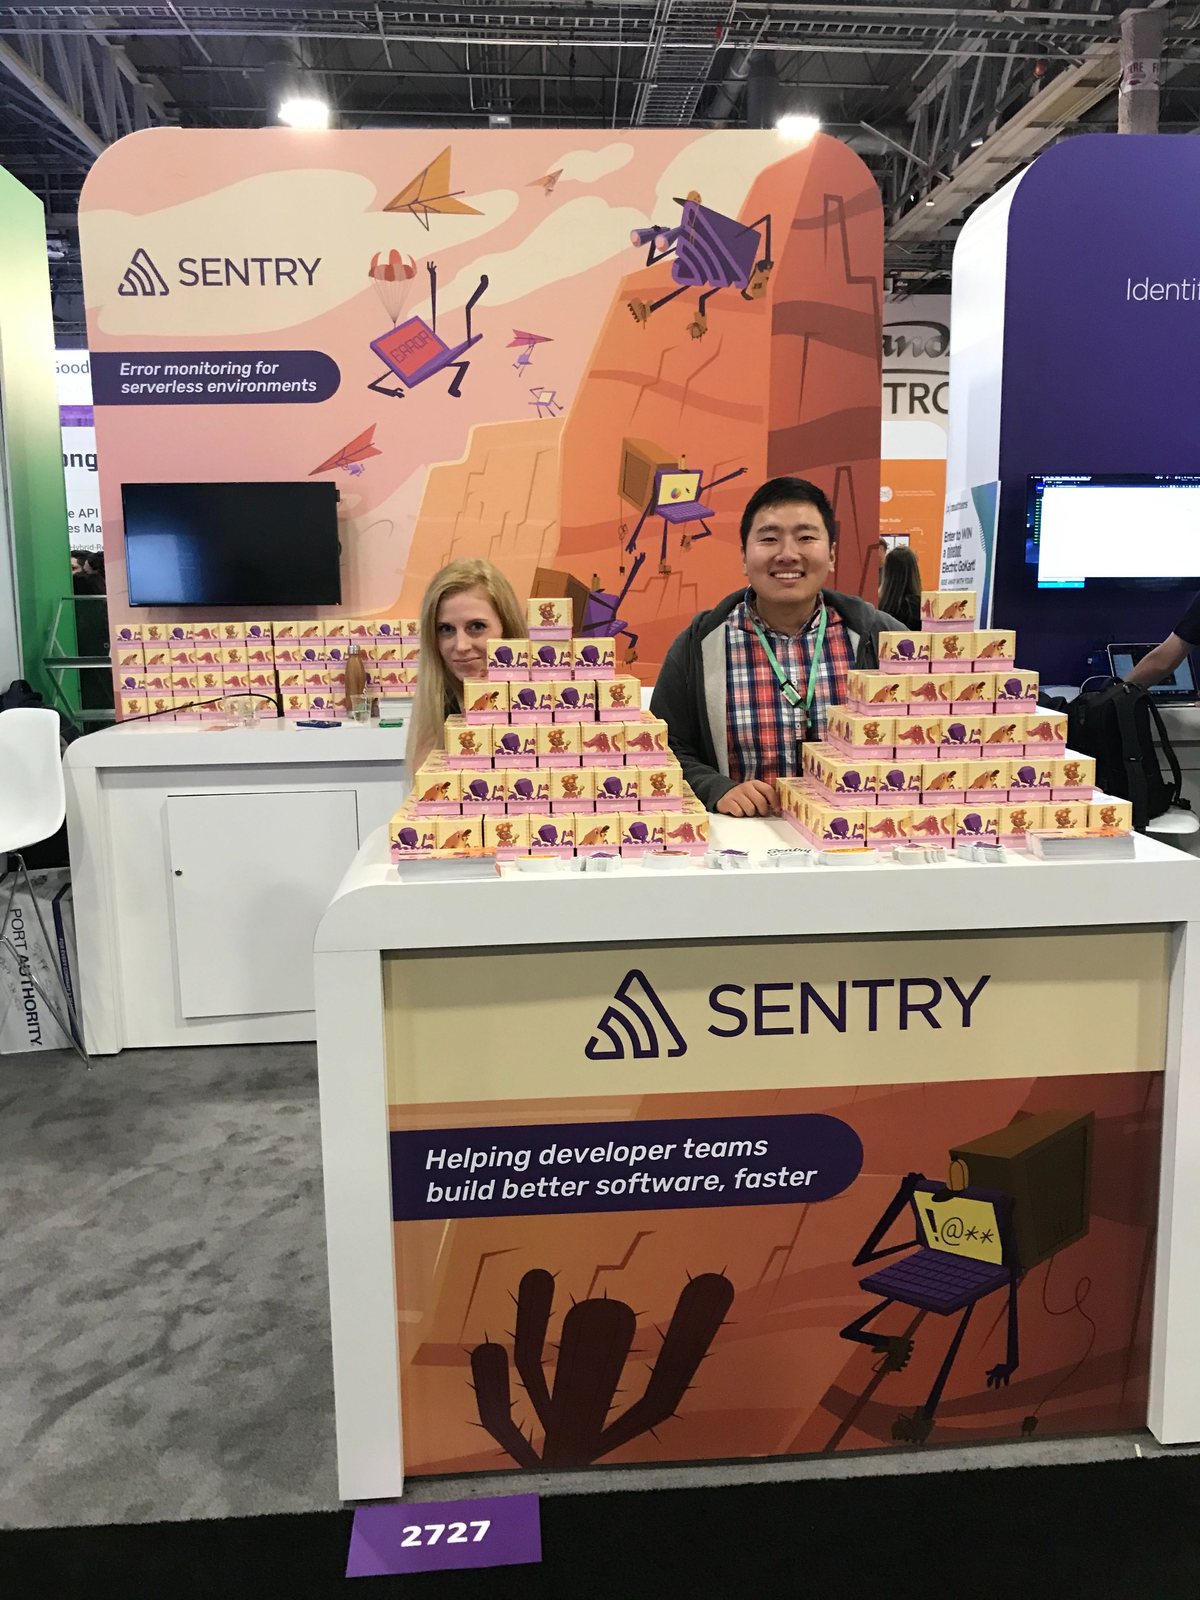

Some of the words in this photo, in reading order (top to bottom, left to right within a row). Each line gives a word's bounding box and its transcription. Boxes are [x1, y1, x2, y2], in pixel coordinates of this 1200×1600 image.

[178, 257, 322, 287] SENTRY
[389, 330, 433, 364] ERROR
[119, 362, 161, 376] Error
[164, 361, 251, 378] monitoring
[255, 361, 279, 375] for
[121, 380, 203, 394] serverless
[207, 378, 317, 393] environments
[78, 508, 98, 518] API
[962, 527, 973, 539] WIN
[9, 908, 28, 950] PORT
[707, 974, 991, 1038] SENTRY
[425, 1145, 531, 1172] Helping
[538, 1142, 677, 1167] developer
[682, 1137, 769, 1159] teams
[425, 1179, 495, 1203] build
[502, 1176, 589, 1200] better
[595, 1171, 725, 1196] software,
[733, 1166, 818, 1190] faster
[400, 1520, 491, 1547] 2727
